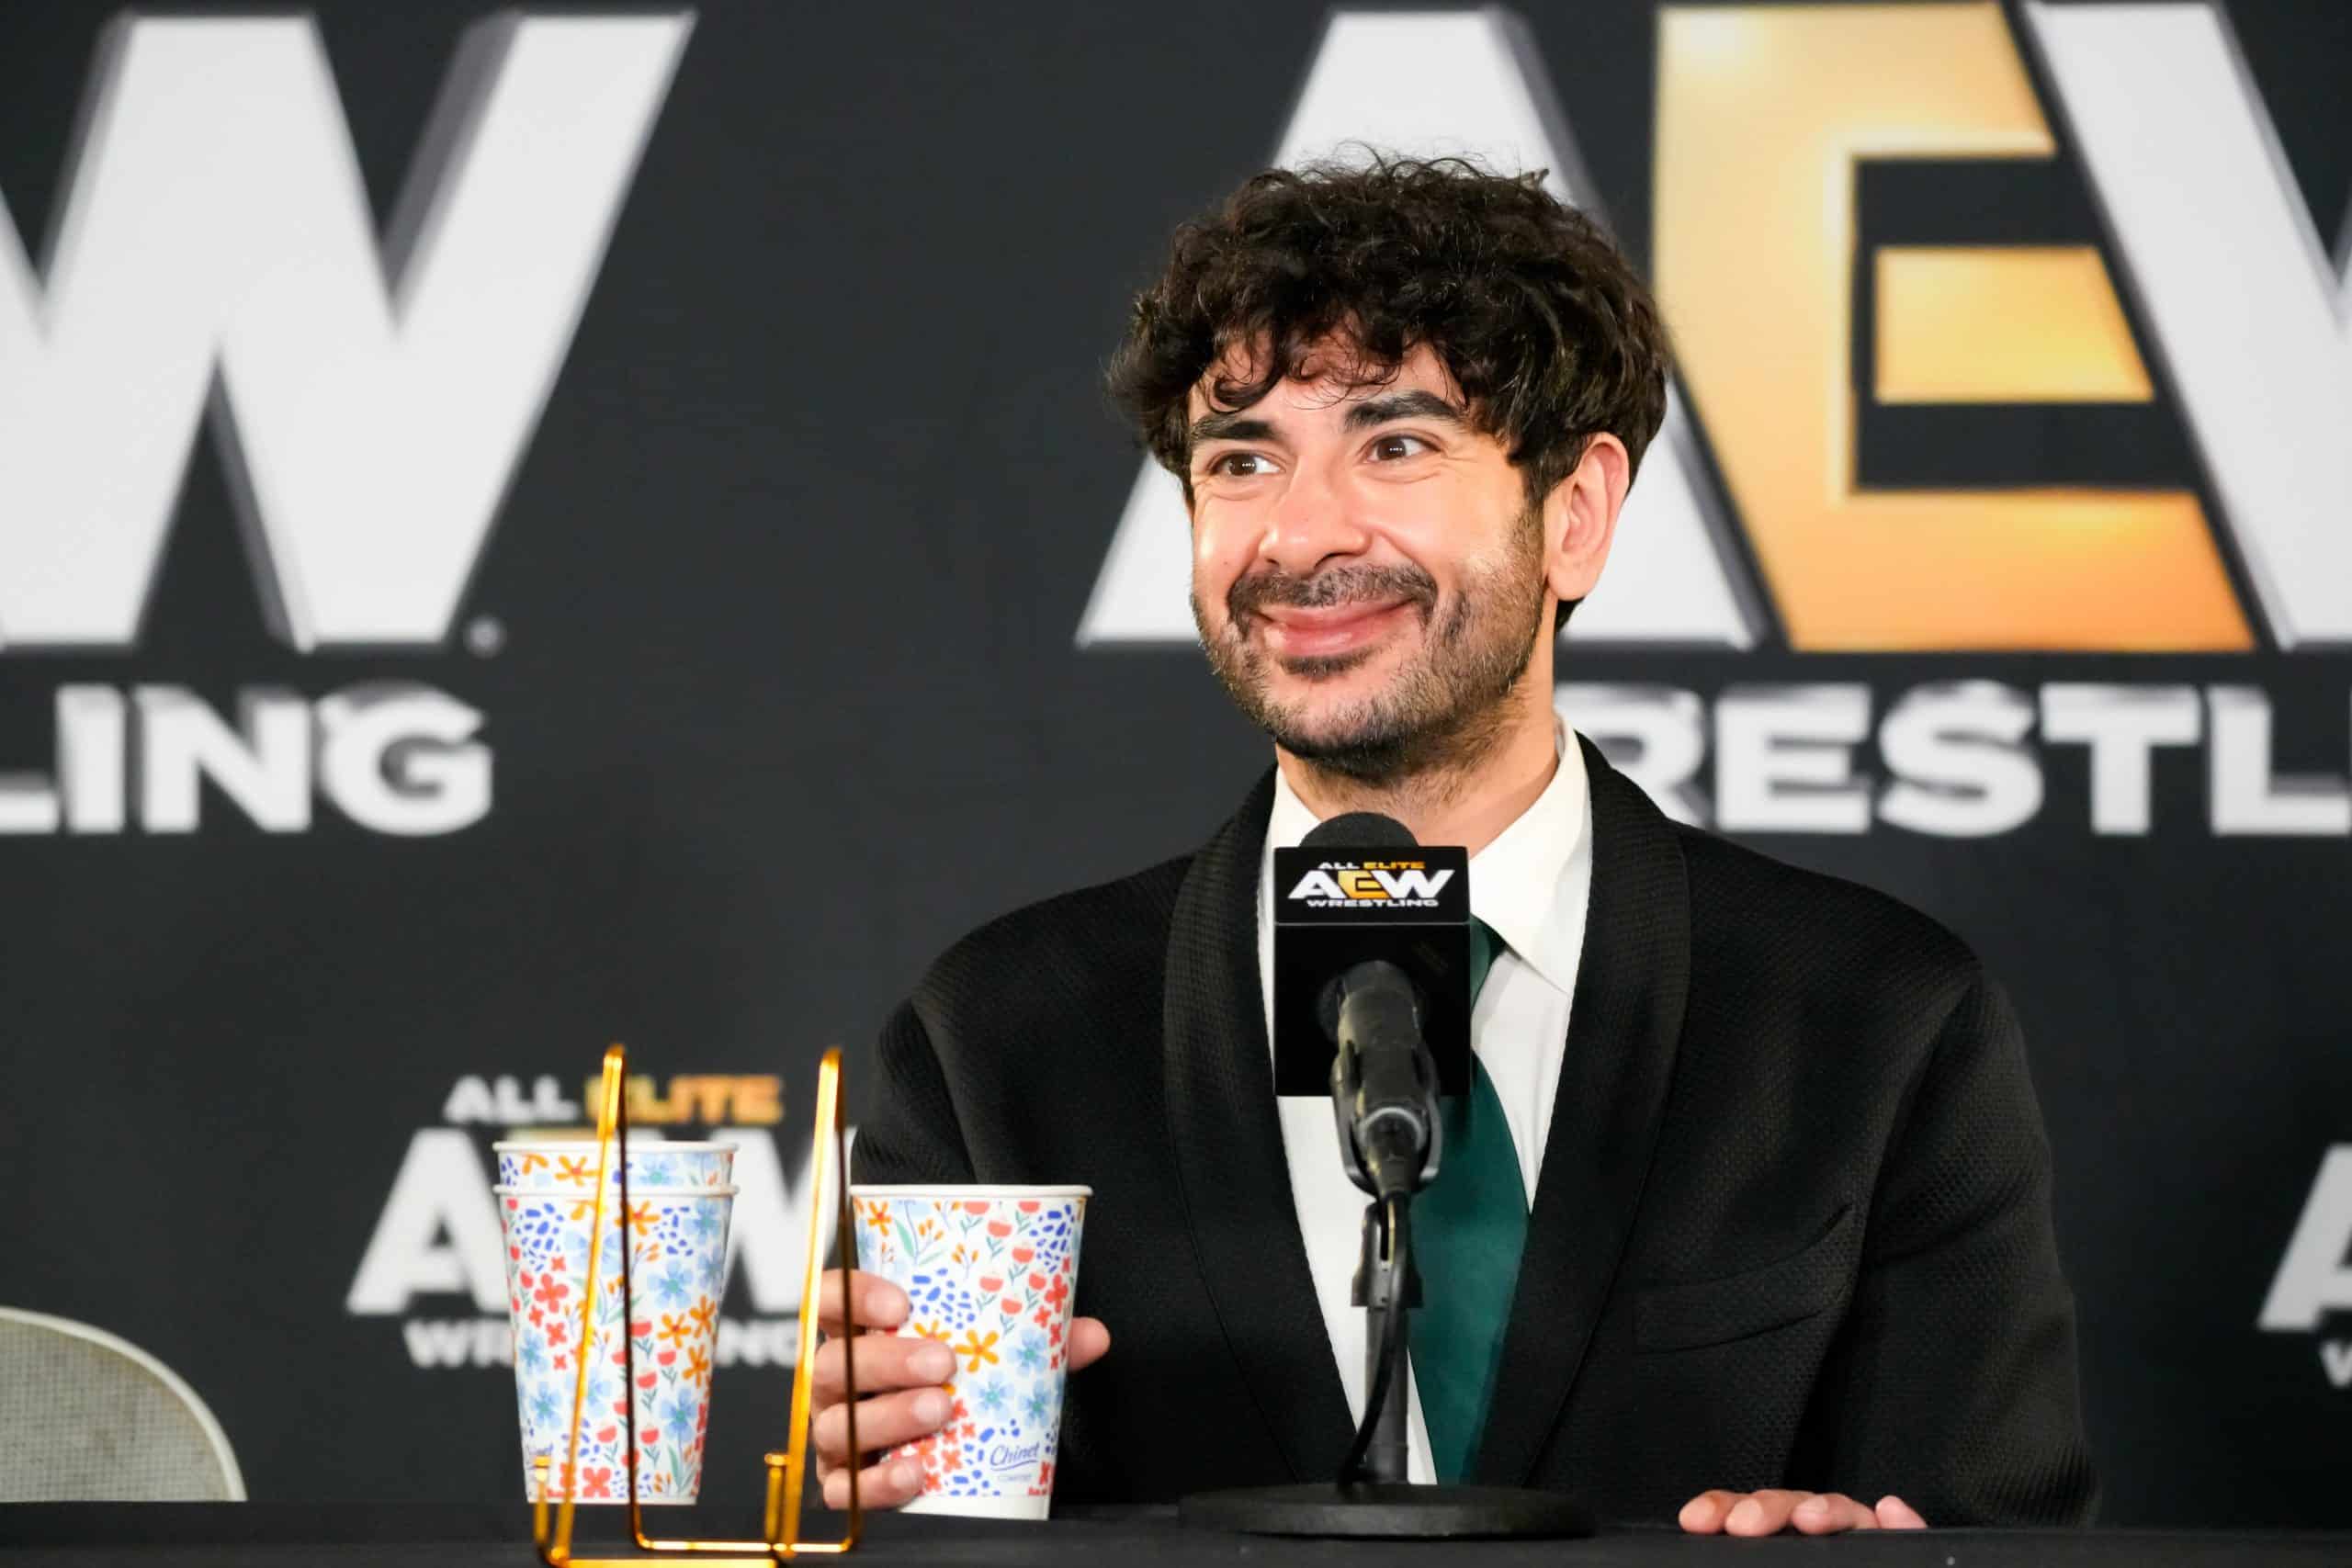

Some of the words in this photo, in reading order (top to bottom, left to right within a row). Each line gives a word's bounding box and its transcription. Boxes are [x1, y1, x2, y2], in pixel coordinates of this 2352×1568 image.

[1553, 679, 2352, 837] RESTL
[1317, 862, 1360, 870] ALL
[1363, 862, 1426, 870] ELITE
[1288, 869, 1455, 900] AEW
[1306, 898, 1440, 908] WRESTLING
[443, 1075, 577, 1123] ALL
[345, 1127, 857, 1314] AW
[989, 1441, 1040, 1466] Chinet
